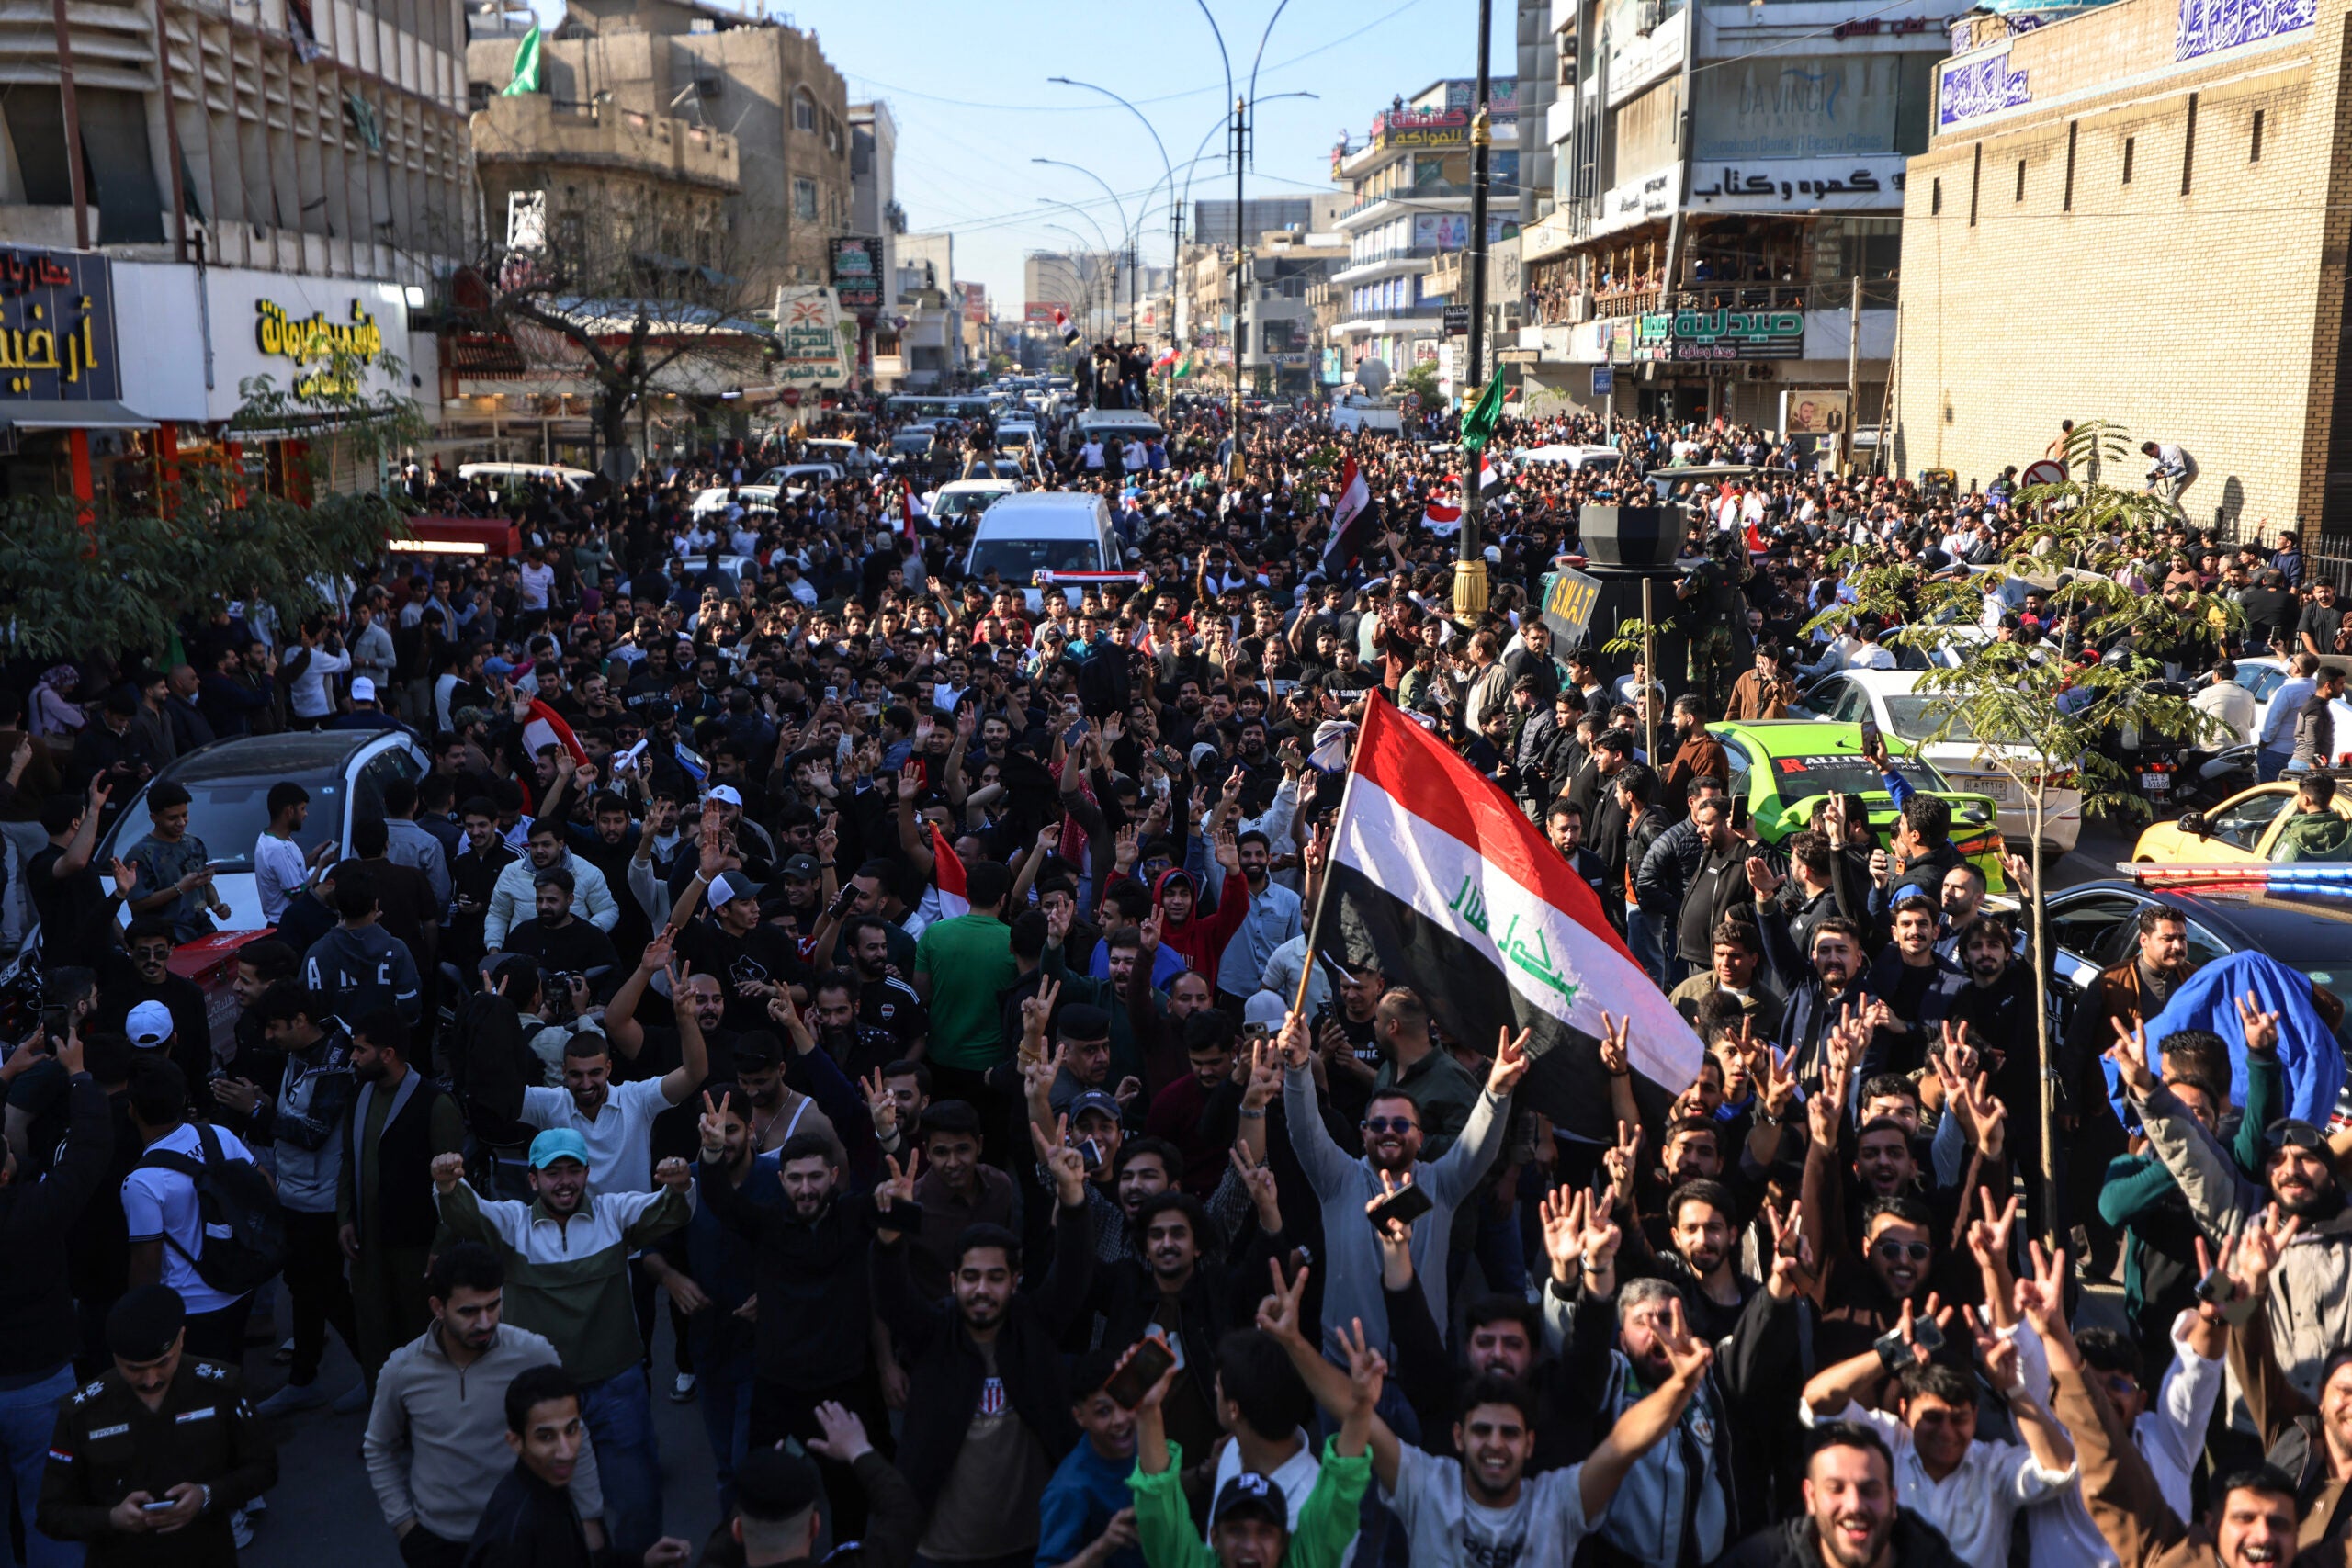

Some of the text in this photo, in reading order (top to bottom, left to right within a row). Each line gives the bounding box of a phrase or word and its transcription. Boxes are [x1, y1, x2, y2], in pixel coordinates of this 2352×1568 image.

[1738, 81, 1825, 115] DA VINCI
[1737, 114, 1825, 130] CLINICS
[1701, 135, 1757, 155] Specialized
[1760, 135, 1792, 152] Dental
[1808, 134, 1844, 151] Beauty
[1846, 132, 1882, 150] Clinics
[1694, 166, 1776, 203] كتاب
[1781, 181, 1792, 200] و
[1674, 308, 1804, 344] صيدلية
